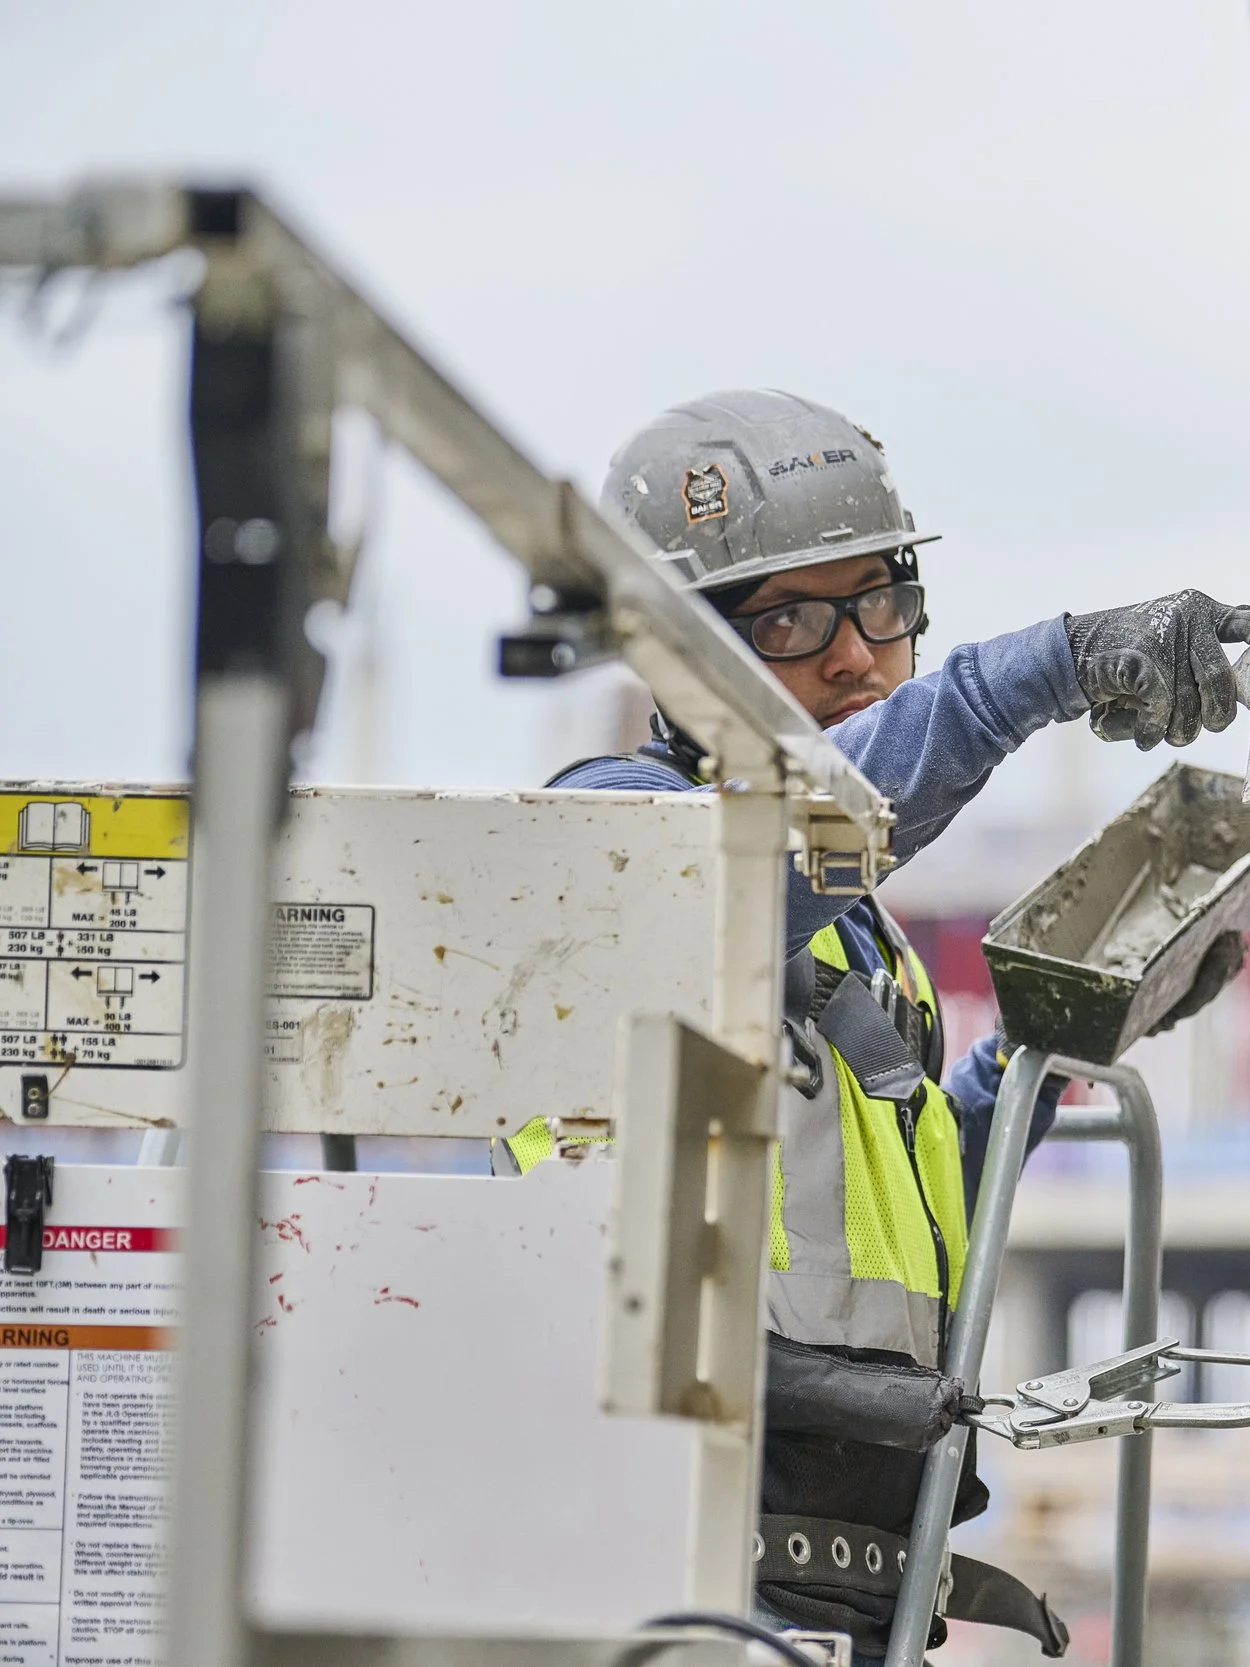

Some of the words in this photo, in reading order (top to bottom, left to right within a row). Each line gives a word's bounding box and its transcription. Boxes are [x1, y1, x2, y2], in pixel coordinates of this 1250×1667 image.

[72, 913, 94, 922] MAX
[275, 908, 345, 922] ARNING
[109, 920, 126, 928] 200
[130, 920, 137, 928] N
[9, 931, 27, 940] 507
[31, 932, 45, 941] LB
[77, 933, 95, 942] 331
[100, 933, 114, 942] LB
[8, 944, 26, 952] 230
[30, 945, 43, 955] kg
[98, 946, 111, 956] kg
[67, 1017, 89, 1026] MAX
[119, 1013, 131, 1021] LB
[124, 1024, 131, 1032] N
[265, 1021, 301, 1030] ES-001
[1, 1035, 20, 1044] 507
[23, 1035, 37, 1044] LB
[102, 1038, 116, 1046] LB
[23, 1048, 35, 1059] kg
[82, 1050, 94, 1058] 70
[98, 1050, 110, 1060] kg
[42, 1230, 132, 1249] DANGER
[83, 1307, 106, 1315] death
[1, 1329, 70, 1347] RNING
[77, 1353, 94, 1361] THIS
[97, 1353, 141, 1362] MACHINE
